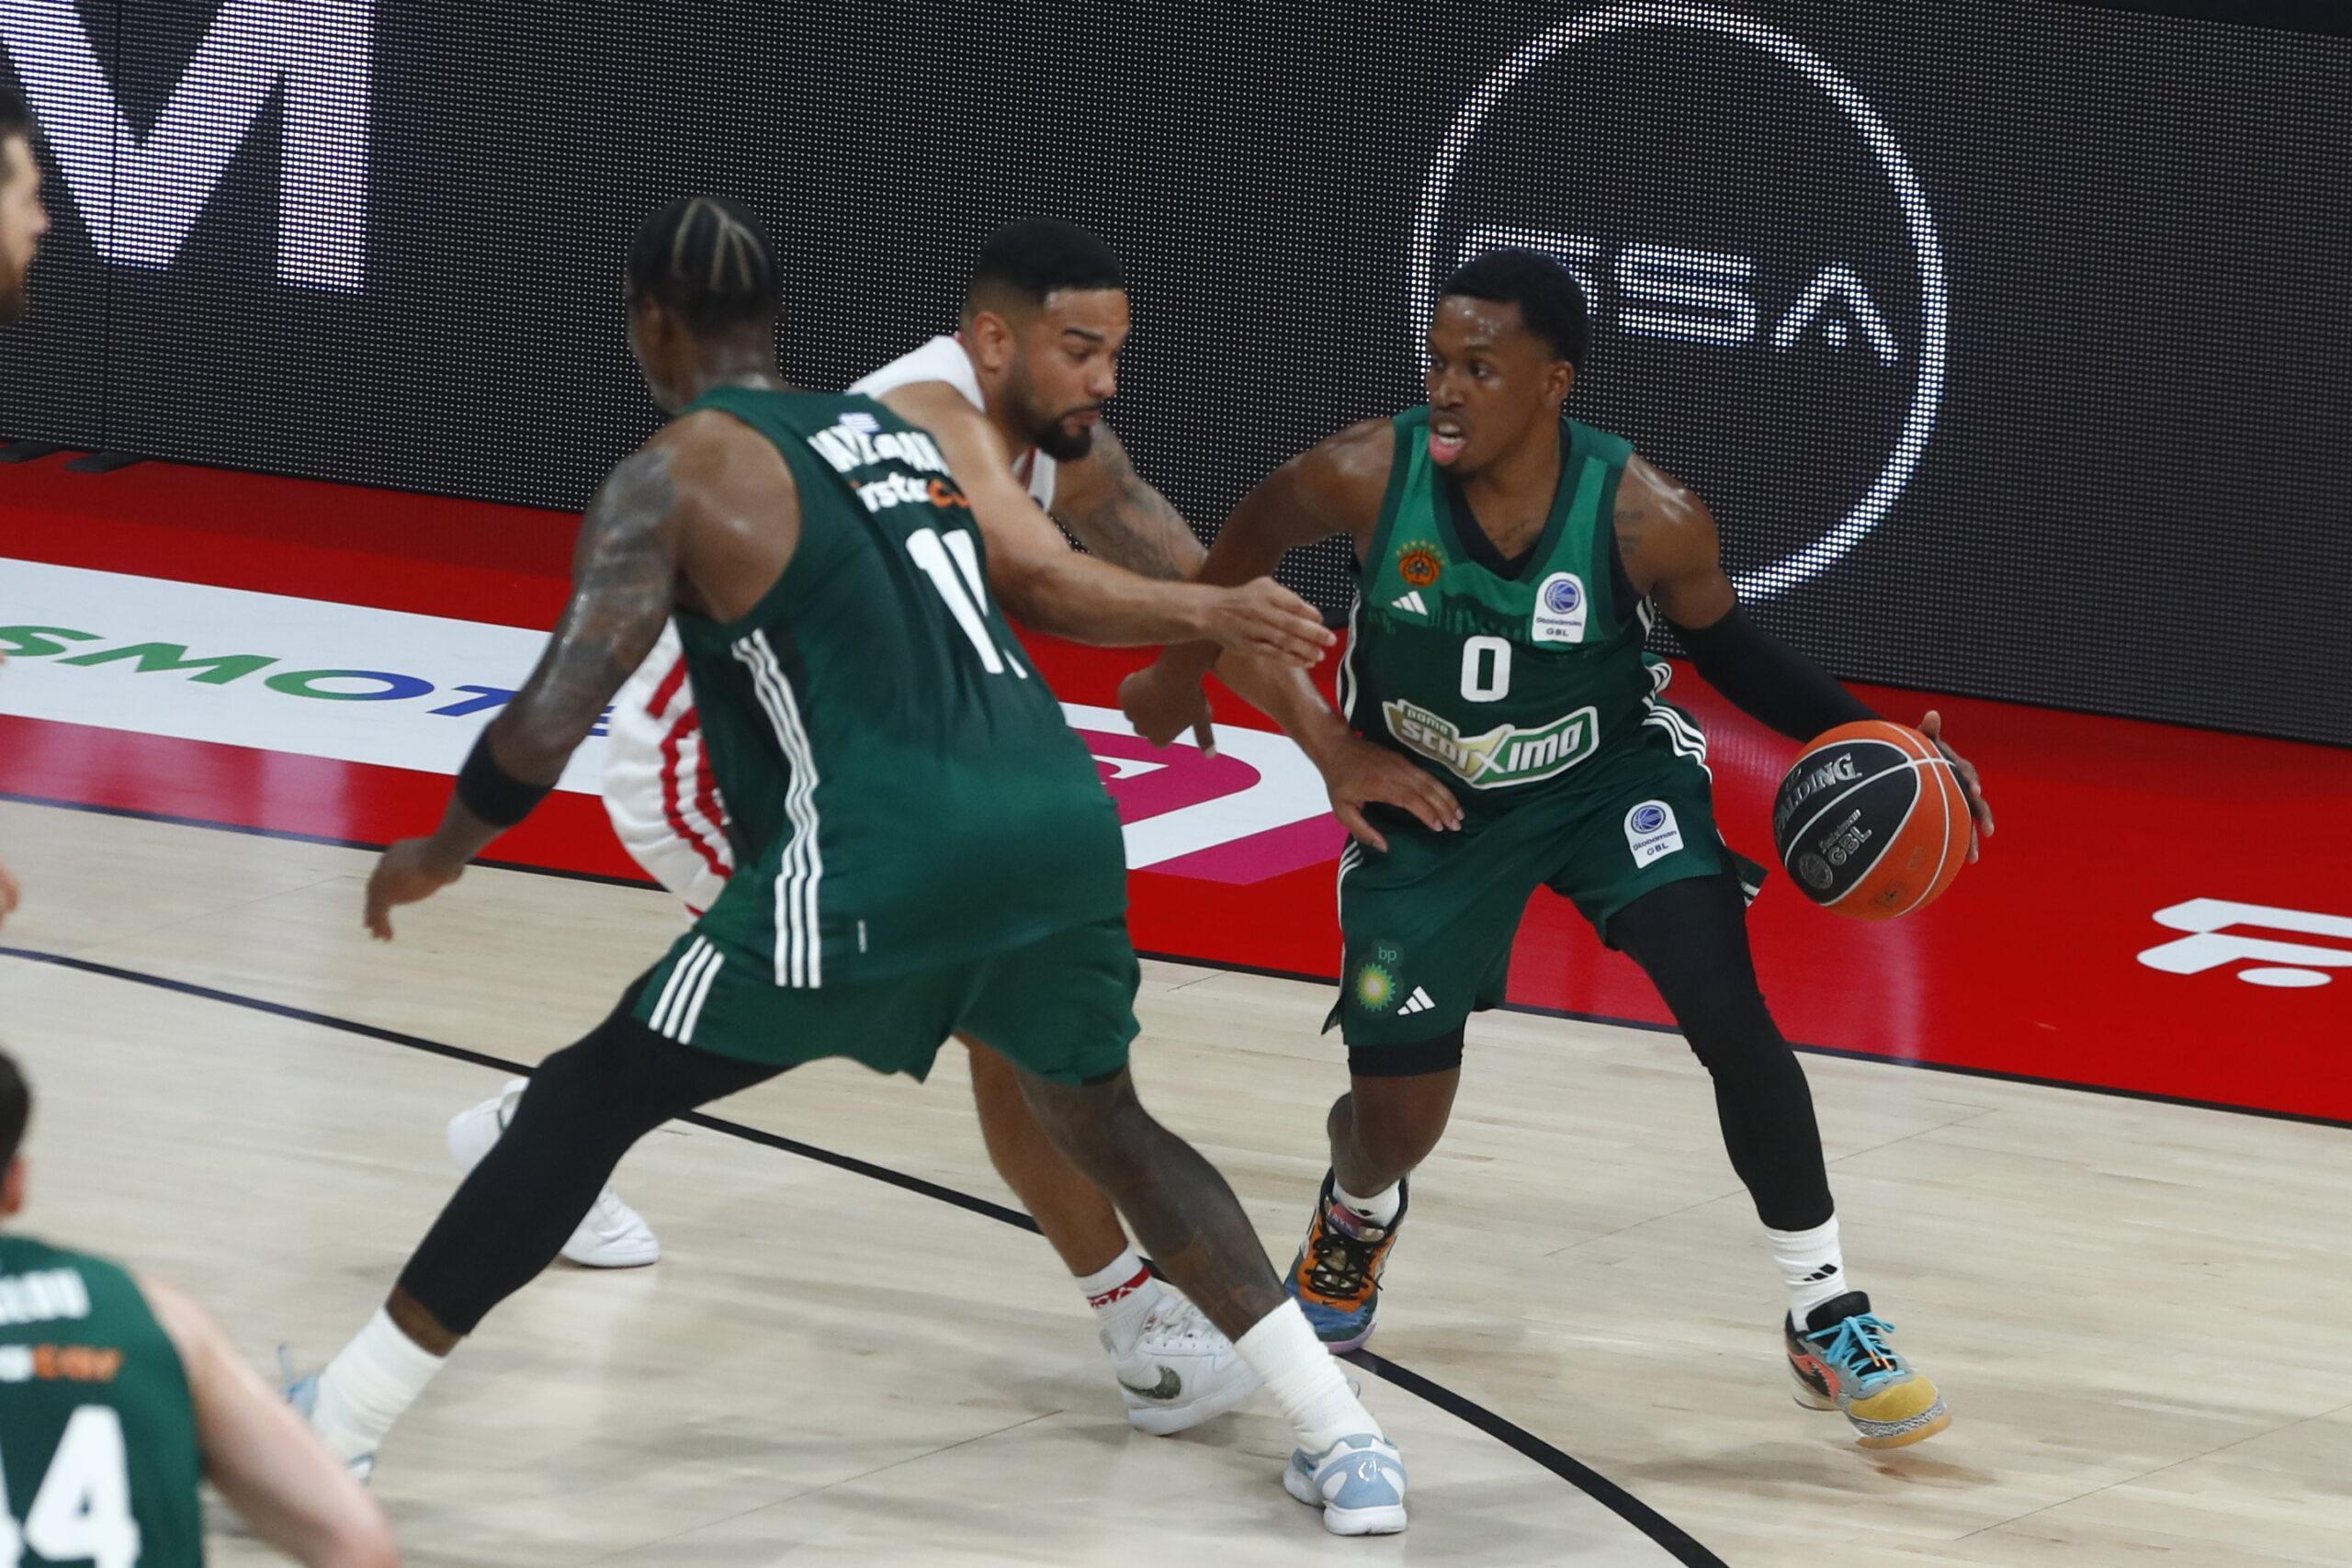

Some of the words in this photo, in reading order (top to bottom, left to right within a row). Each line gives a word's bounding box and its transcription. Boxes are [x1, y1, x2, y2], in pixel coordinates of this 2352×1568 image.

[0, 626, 616, 737] SMOT
[1461, 636, 1511, 702] 0
[1646, 842, 1668, 856] GBL
[1827, 826, 1872, 866] GBL
[1378, 946, 1397, 963] bp
